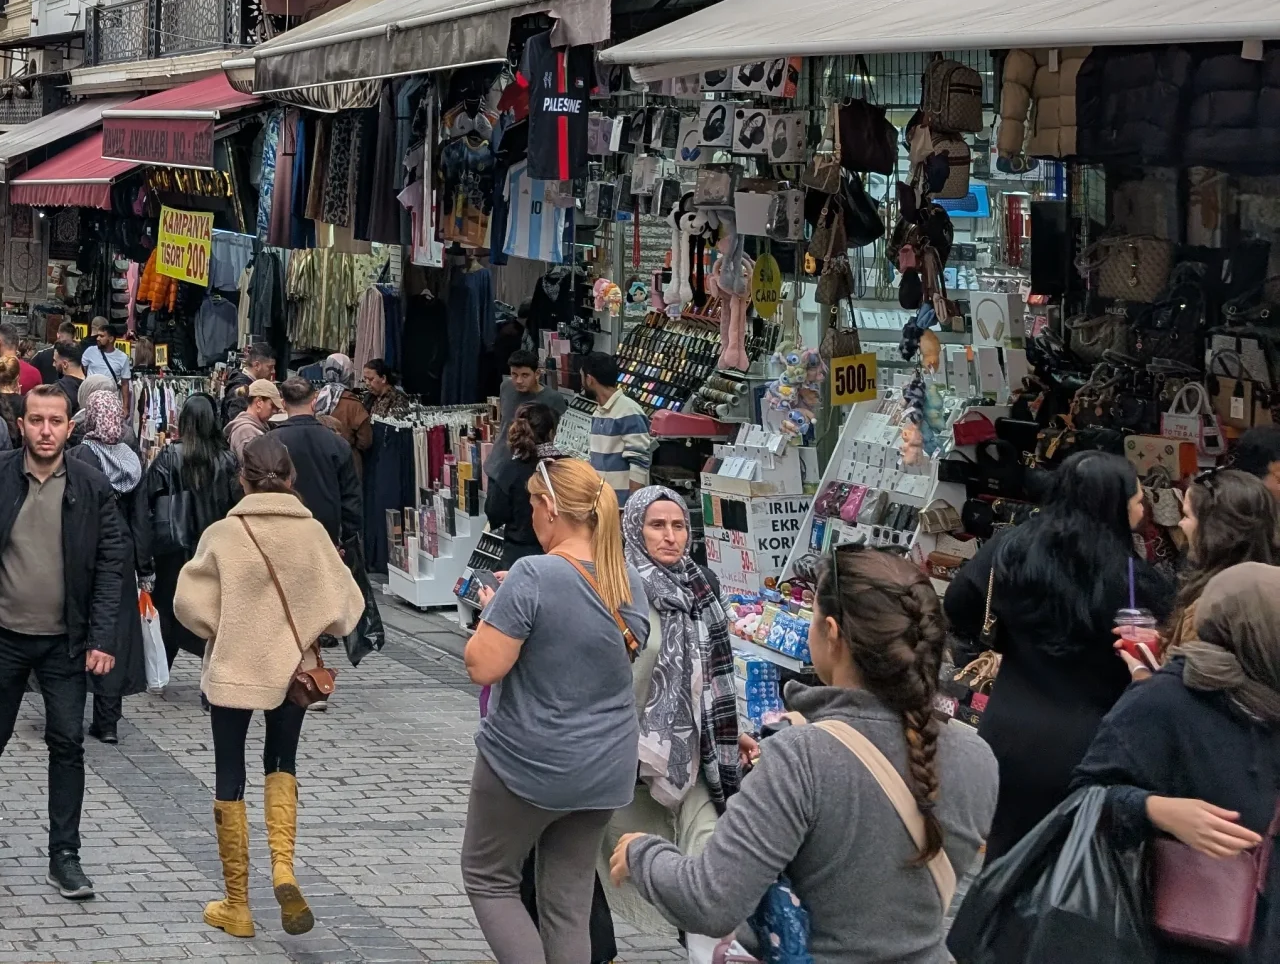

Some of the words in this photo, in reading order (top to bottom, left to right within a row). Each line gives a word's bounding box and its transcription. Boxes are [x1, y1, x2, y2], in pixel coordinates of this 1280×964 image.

[531, 200, 543, 215] 10
[163, 210, 210, 241] KAMPANYA
[186, 242, 206, 280] 200
[755, 288, 777, 303] CARD
